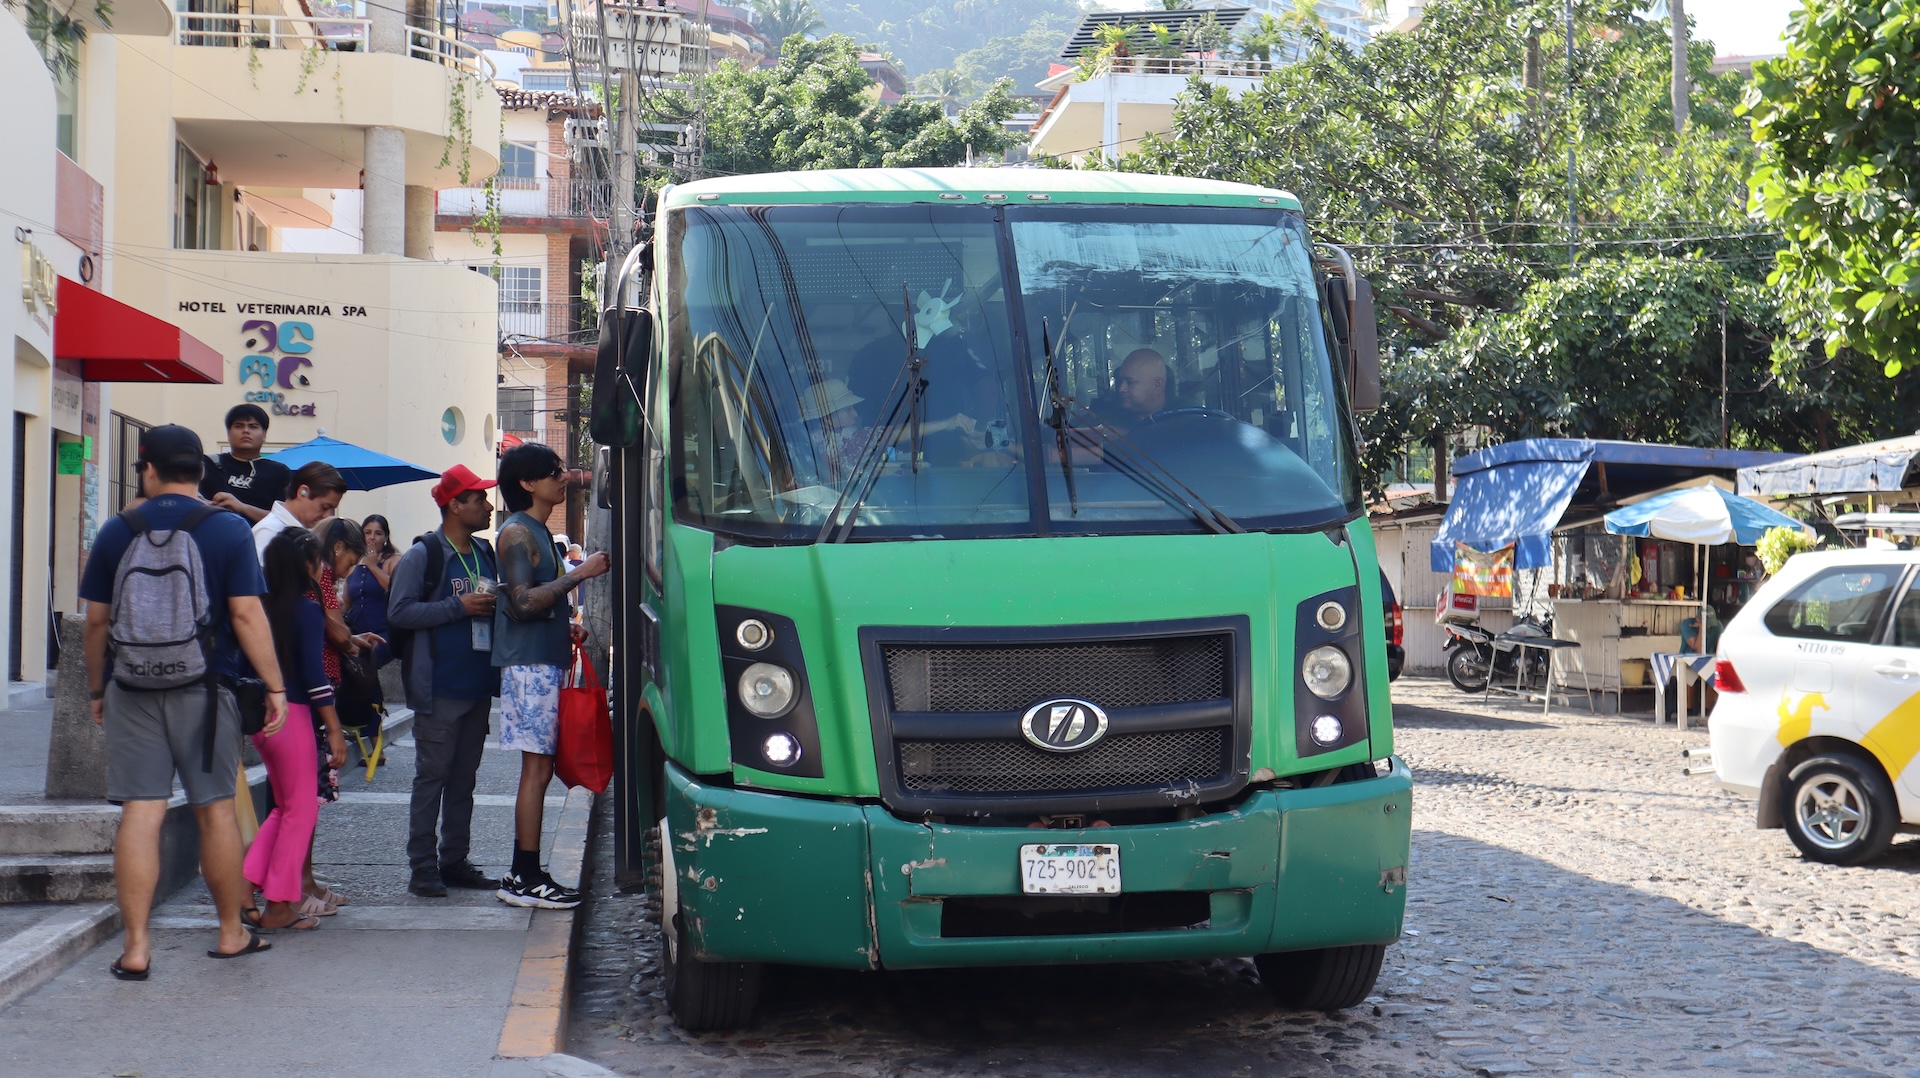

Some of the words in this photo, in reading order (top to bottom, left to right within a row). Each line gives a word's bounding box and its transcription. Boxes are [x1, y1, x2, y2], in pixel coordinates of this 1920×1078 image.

[178, 301, 227, 313] HOTEL
[237, 303, 332, 316] VETERINARIA
[342, 306, 367, 317] SPA
[1796, 641, 1828, 654] SITIO
[1026, 858, 1116, 880] 725-902-G
